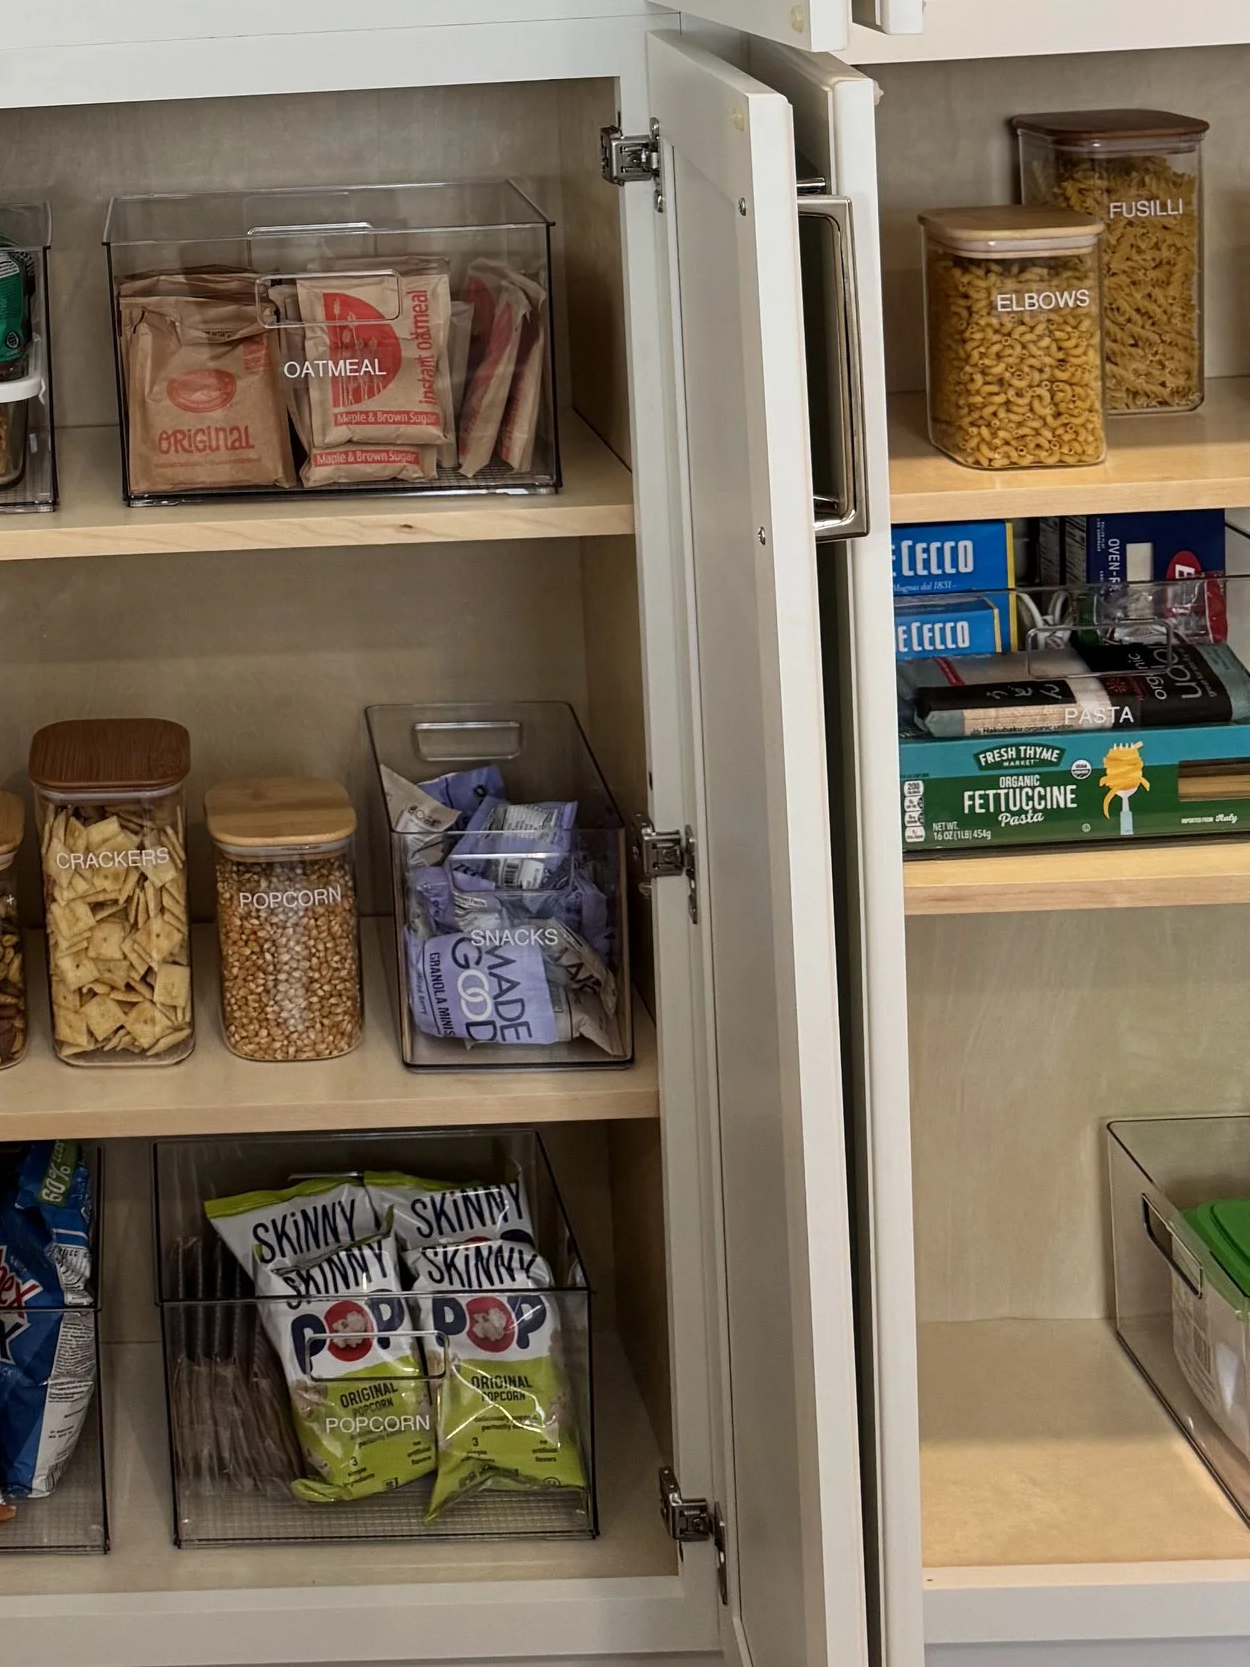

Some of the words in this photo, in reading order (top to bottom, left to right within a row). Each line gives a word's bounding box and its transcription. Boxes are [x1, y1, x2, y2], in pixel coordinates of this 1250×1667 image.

[1109, 198, 1184, 219] FUSILLI
[996, 289, 1091, 312] ELBOWS
[406, 289, 434, 350] oatmeal
[283, 358, 387, 379] OATMEAL
[417, 354, 438, 406] instant
[377, 412, 408, 423] Brown
[410, 412, 437, 424] Sugar
[317, 451, 346, 464] Maple
[356, 450, 387, 462] Brown
[389, 449, 417, 464] Sugar
[901, 539, 975, 577] CECCO
[911, 620, 970, 651] CECCO
[1064, 705, 1135, 725] PASTA
[979, 747, 1016, 766] FRESH
[1020, 746, 1061, 762] THYME
[999, 774, 1041, 788] ORGANIC
[963, 784, 1078, 814] FETTUCCINE
[998, 810, 1045, 827] Pasta
[1215, 813, 1238, 824] Italy
[55, 847, 170, 870] CRACKERS
[238, 884, 342, 911] POPCORN
[470, 928, 560, 946] SNACKS
[429, 951, 446, 1005] GRANOLA
[451, 936, 498, 1042] GOOD
[484, 943, 533, 1042] MADE
[41, 1165, 71, 1203] 60%
[411, 1182, 526, 1238] SKINNY
[253, 1198, 356, 1264] SKINNY
[428, 1243, 539, 1290] SKINNY
[290, 1291, 406, 1376] POP
[432, 1294, 547, 1353] POP
[339, 1382, 399, 1408] ORIGINAL
[470, 1375, 533, 1389] ORIGINAL
[325, 1414, 430, 1434] POPCORN
[472, 1437, 479, 1447] 3
